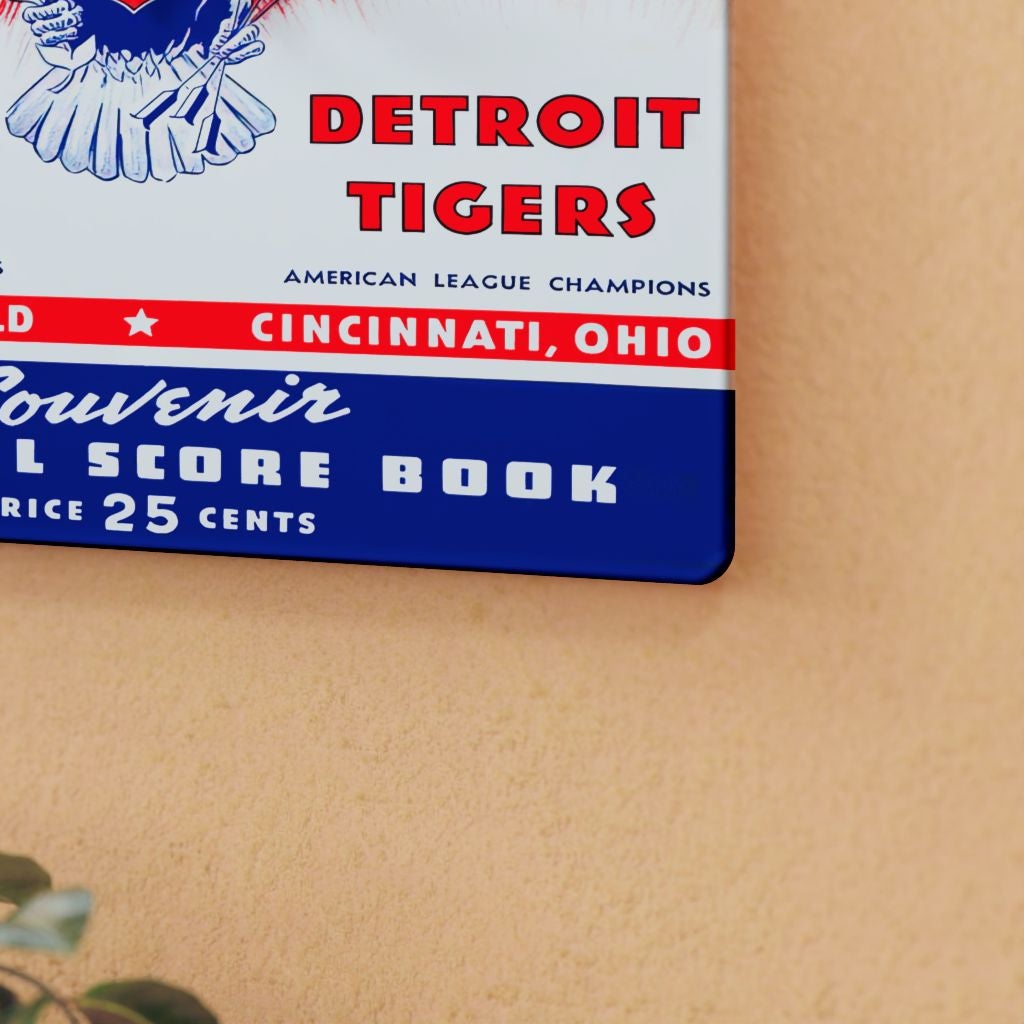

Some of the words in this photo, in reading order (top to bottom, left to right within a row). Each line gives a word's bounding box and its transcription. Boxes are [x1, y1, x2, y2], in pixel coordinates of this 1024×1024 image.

[309, 94, 700, 149] DETROIT
[346, 181, 655, 238] TIGERS
[284, 269, 416, 286] AMERICAN
[434, 273, 530, 290] LEAGUE
[549, 277, 711, 297] CHAMPIONS
[251, 312, 557, 357] CINCINNATI,
[575, 322, 711, 359] OHIO
[88, 442, 330, 489] SCORE
[382, 455, 617, 504] BOOK
[103, 493, 178, 534] 25
[199, 507, 316, 534] CENTS
